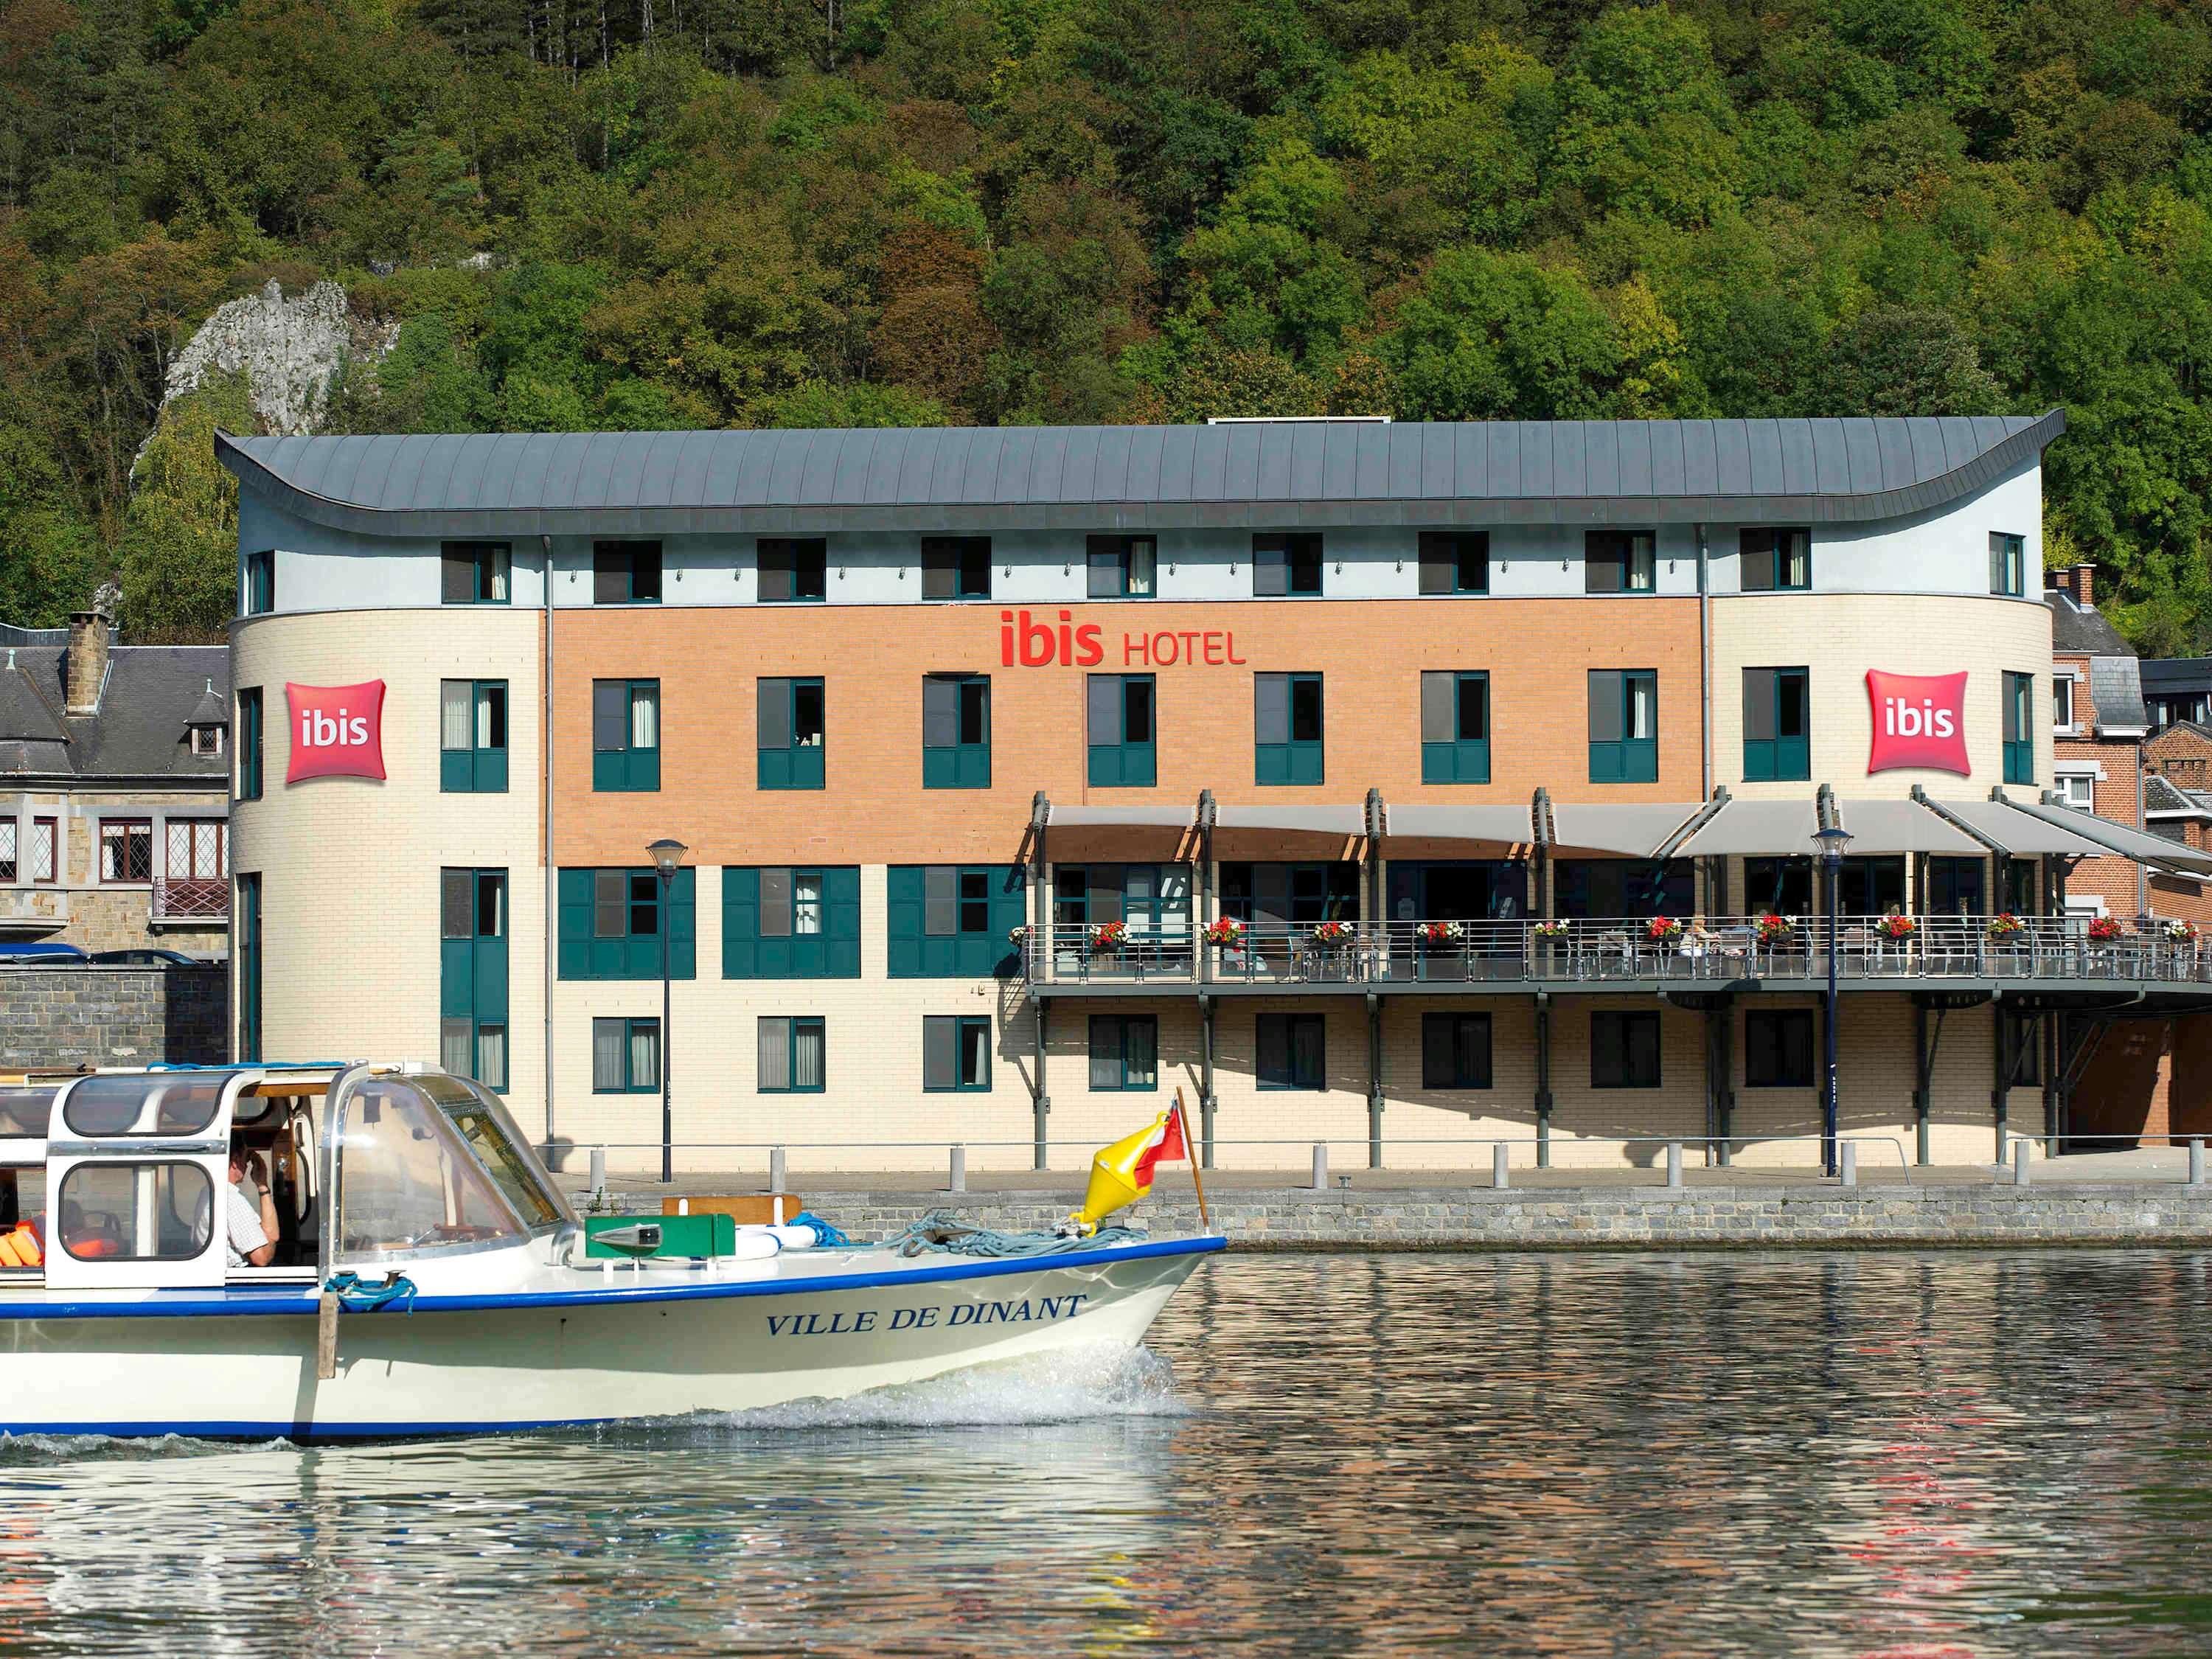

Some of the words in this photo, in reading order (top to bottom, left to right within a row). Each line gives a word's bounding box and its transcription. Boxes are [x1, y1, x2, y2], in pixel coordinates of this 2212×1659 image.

[1000, 609, 1104, 667] ibis
[1123, 630, 1247, 666] HOTEL
[302, 708, 369, 746] ibis
[1885, 697, 1954, 738] ibis
[766, 1311, 878, 1336] VILLE
[887, 1306, 941, 1330] DE
[945, 1293, 1088, 1326] DINANT
